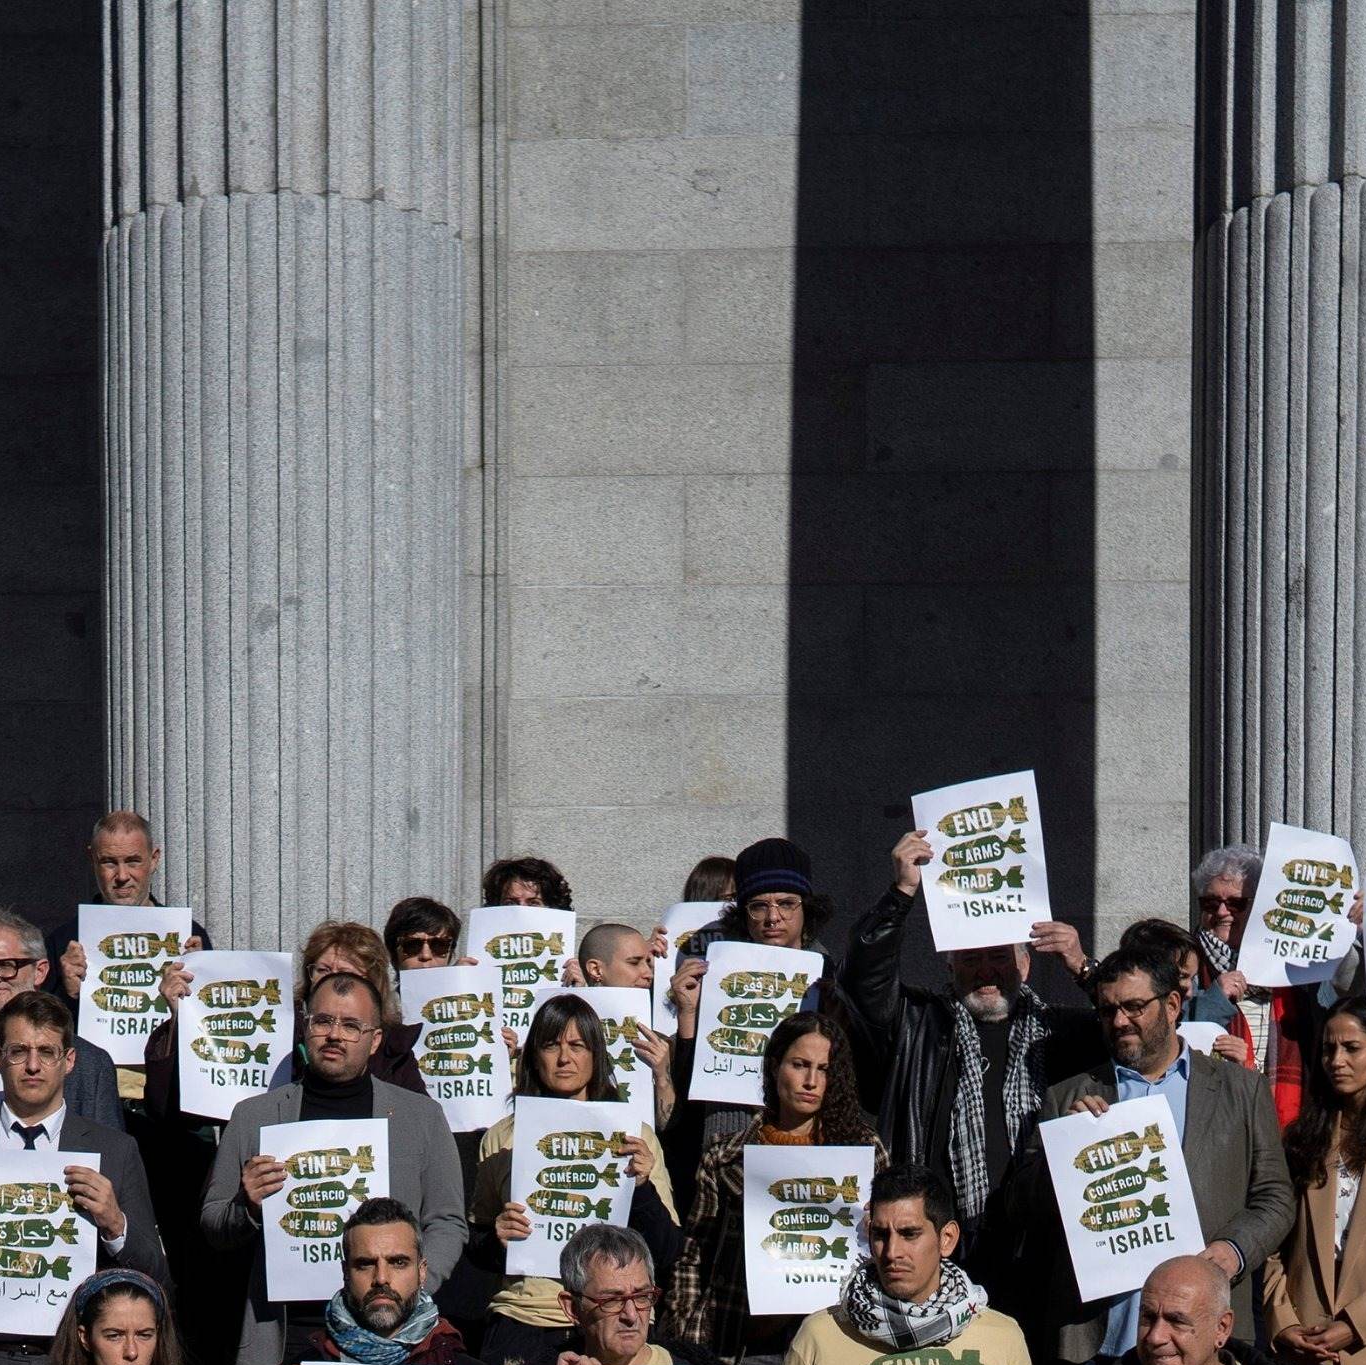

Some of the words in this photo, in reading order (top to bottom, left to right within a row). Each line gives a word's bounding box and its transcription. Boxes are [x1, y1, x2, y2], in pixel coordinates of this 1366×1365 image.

[952, 808, 993, 834] END
[966, 842, 1001, 862] ARMS
[953, 873, 994, 888] TRADE
[1294, 863, 1315, 882] FIN
[963, 895, 1026, 917] ISRAEL
[1280, 895, 1324, 908] COMERCIO
[1281, 920, 1310, 935] ARMAS
[114, 937, 149, 956] END
[500, 938, 533, 956] END
[1274, 938, 1328, 960] ISRAEL
[120, 970, 153, 984] ARMS
[105, 994, 142, 1008] TRADE
[211, 987, 235, 1005] FIN
[434, 1004, 457, 1018] FIN
[430, 1033, 475, 1045] COMERCIO
[211, 1070, 268, 1087] ISRAEL
[438, 1080, 493, 1099] ISRAEL
[552, 1137, 579, 1156] FIN
[298, 1154, 326, 1175] FIN
[1087, 1145, 1118, 1169] FIN
[542, 1172, 596, 1184] COMERCIO
[1088, 1174, 1143, 1199] COMERCIO
[293, 1191, 345, 1205] COMERCIO
[783, 1183, 811, 1200] FIN
[550, 1199, 585, 1213] ARMAS
[776, 1213, 829, 1225] COMERCIO
[1106, 1207, 1141, 1223] ARMAS
[304, 1220, 338, 1232] ARMAS
[1109, 1222, 1175, 1254] ISRAEL
[786, 1242, 821, 1255] ARMAS
[47, 1287, 67, 1305] مع
